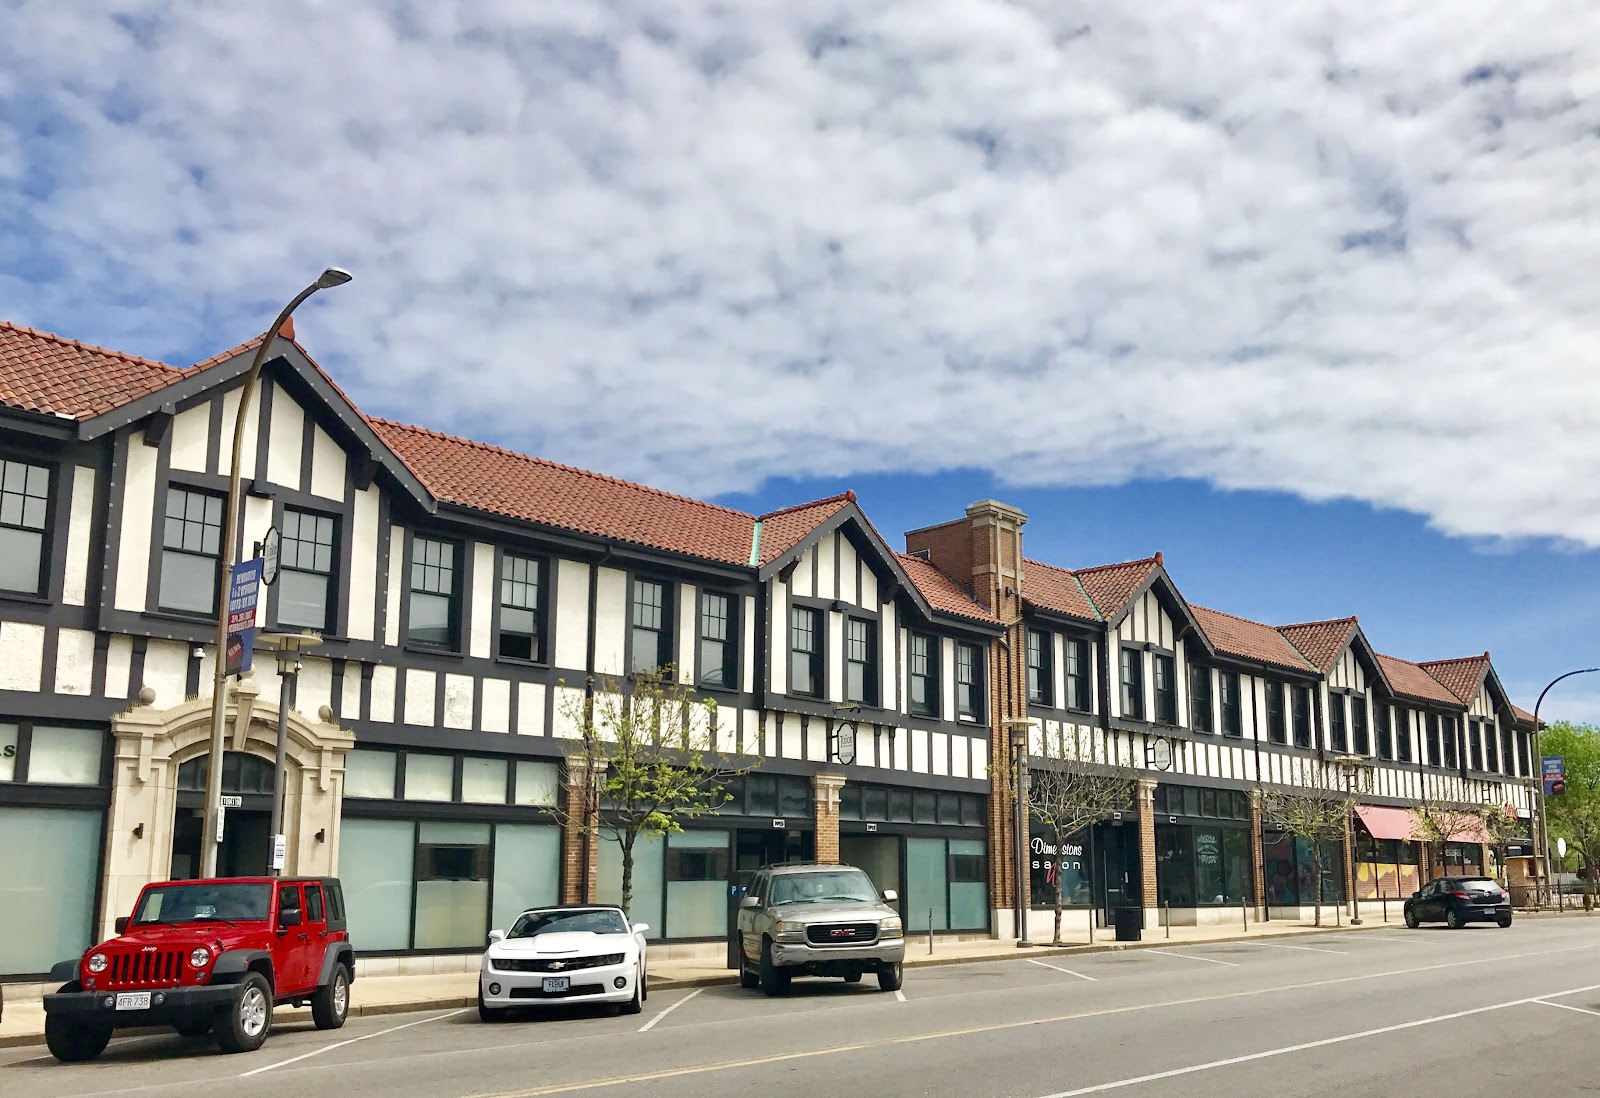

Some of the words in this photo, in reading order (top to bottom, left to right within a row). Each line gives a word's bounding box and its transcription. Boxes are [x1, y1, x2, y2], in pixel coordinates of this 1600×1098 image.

[1031, 837, 1082, 856] Dimesions
[1032, 861, 1081, 870] saon
[830, 928, 855, 936] GMC
